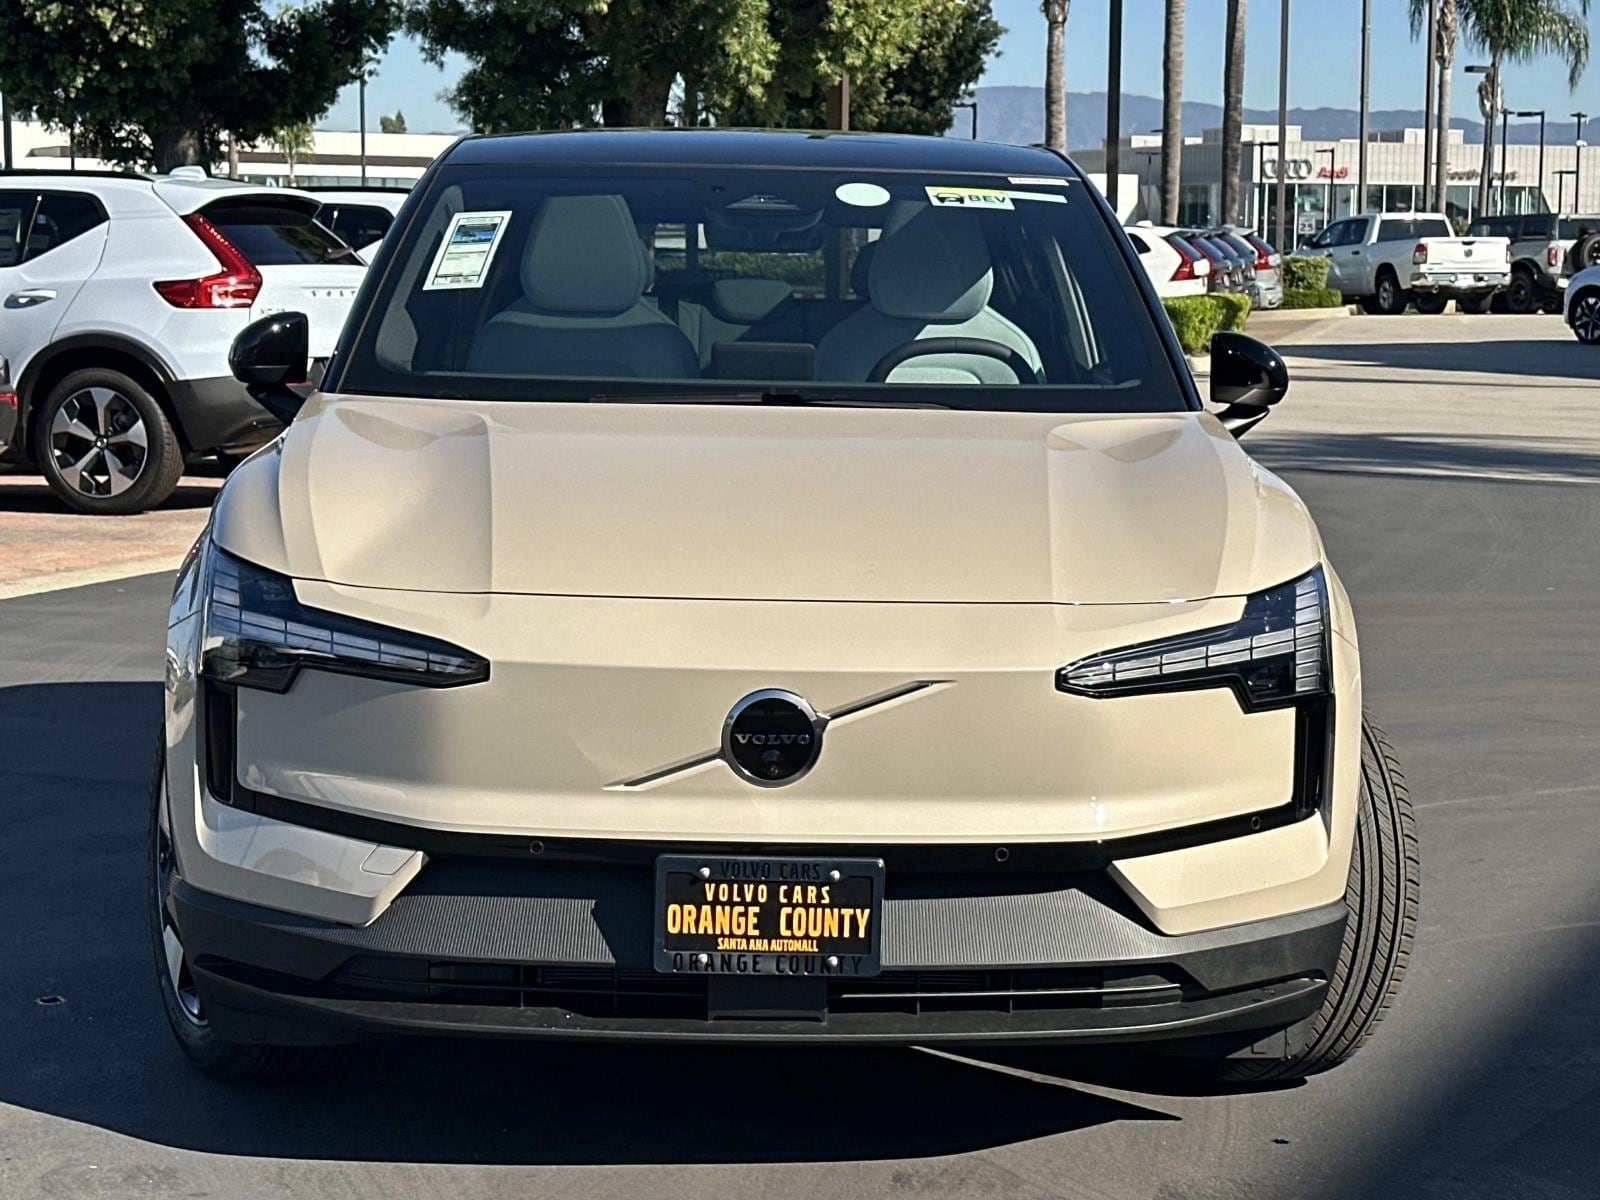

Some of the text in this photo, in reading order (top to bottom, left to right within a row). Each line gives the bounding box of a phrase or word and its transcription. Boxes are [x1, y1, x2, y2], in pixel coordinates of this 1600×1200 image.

[967, 194, 1006, 203] BEV
[1299, 223, 1314, 232] 25
[735, 733, 810, 745] VOLVO
[720, 861, 821, 880] VOLVO CARS
[704, 883, 831, 904] VOLVO CARS
[667, 904, 871, 938] ORANGE COUNTY
[717, 937, 819, 952] SANTA ANA AUTOMALL
[672, 953, 862, 974] ORANGE COUNTY
